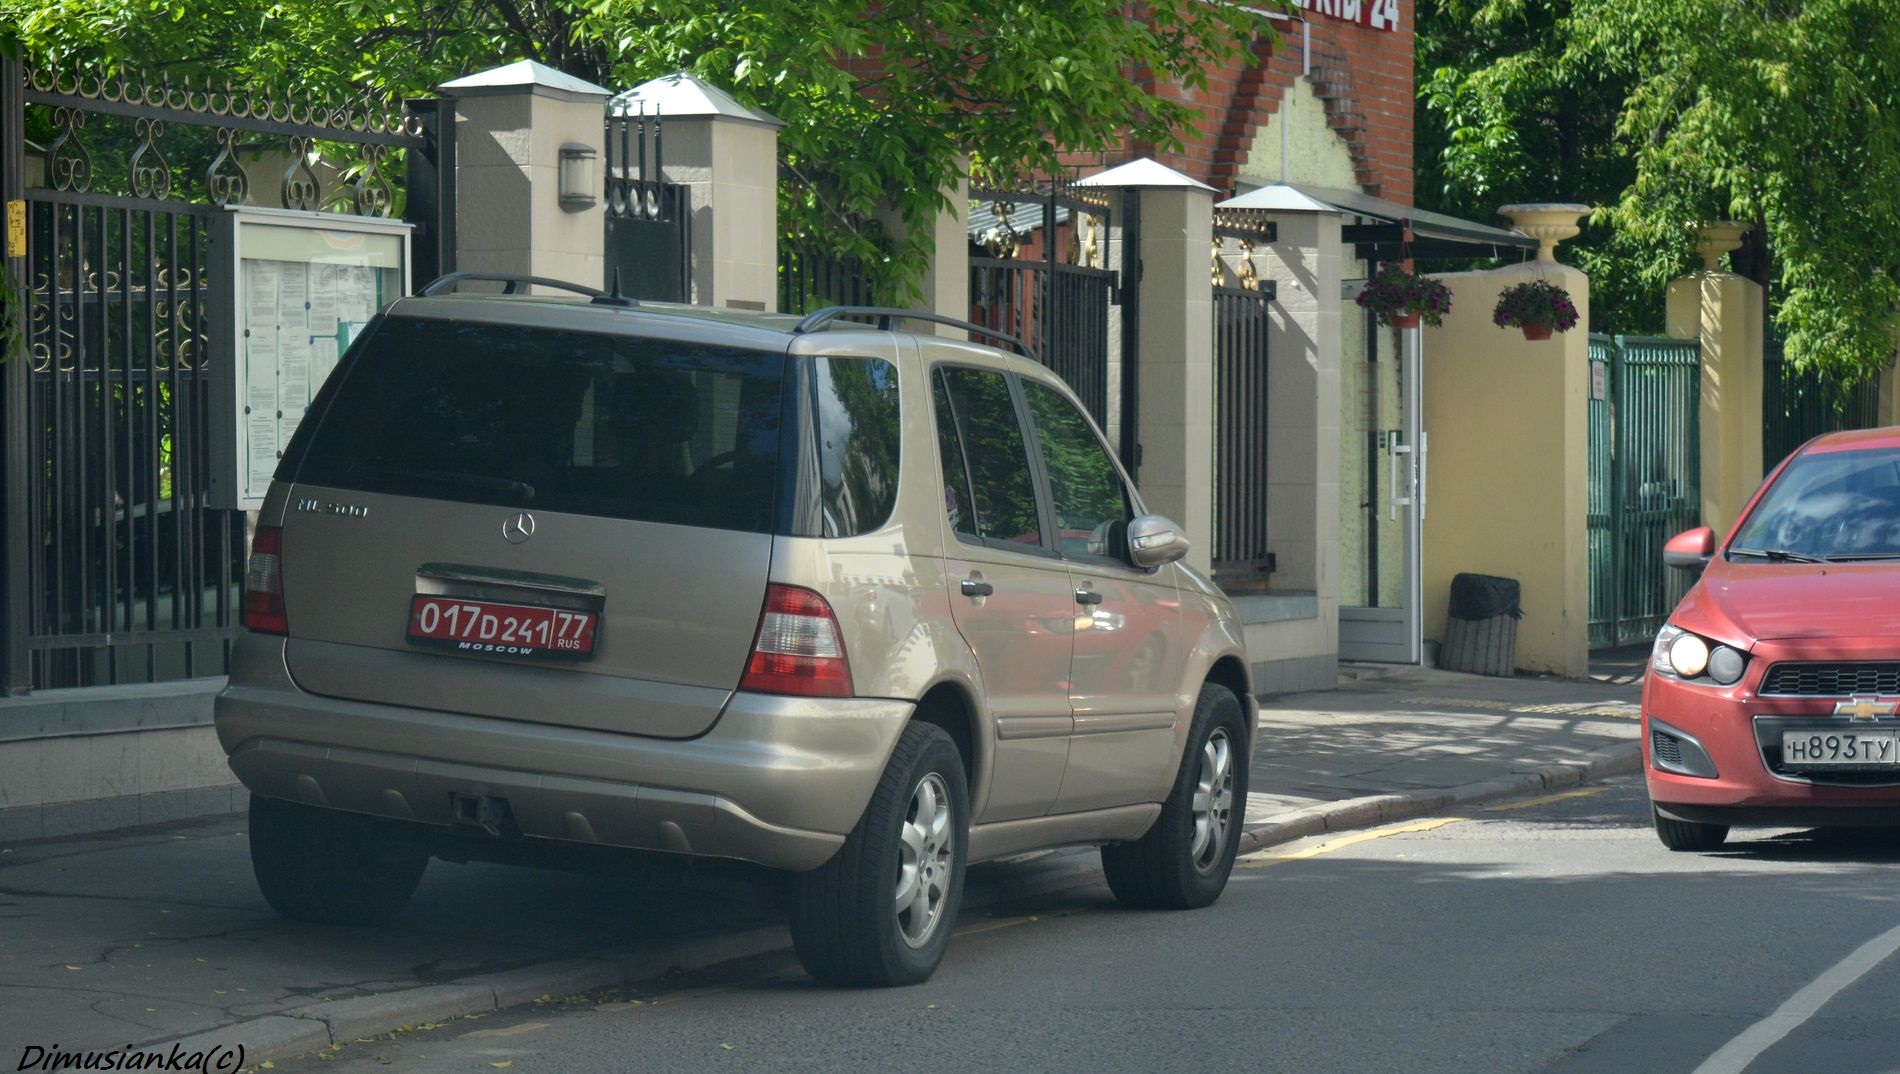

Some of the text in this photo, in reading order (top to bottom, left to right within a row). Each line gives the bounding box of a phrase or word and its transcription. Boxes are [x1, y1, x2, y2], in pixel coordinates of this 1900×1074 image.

[420, 602, 588, 645] 017D241 77
[458, 641, 533, 655] MOSCOW
[557, 639, 581, 649] RUS
[1792, 736, 1890, 760] Н893ТУ
